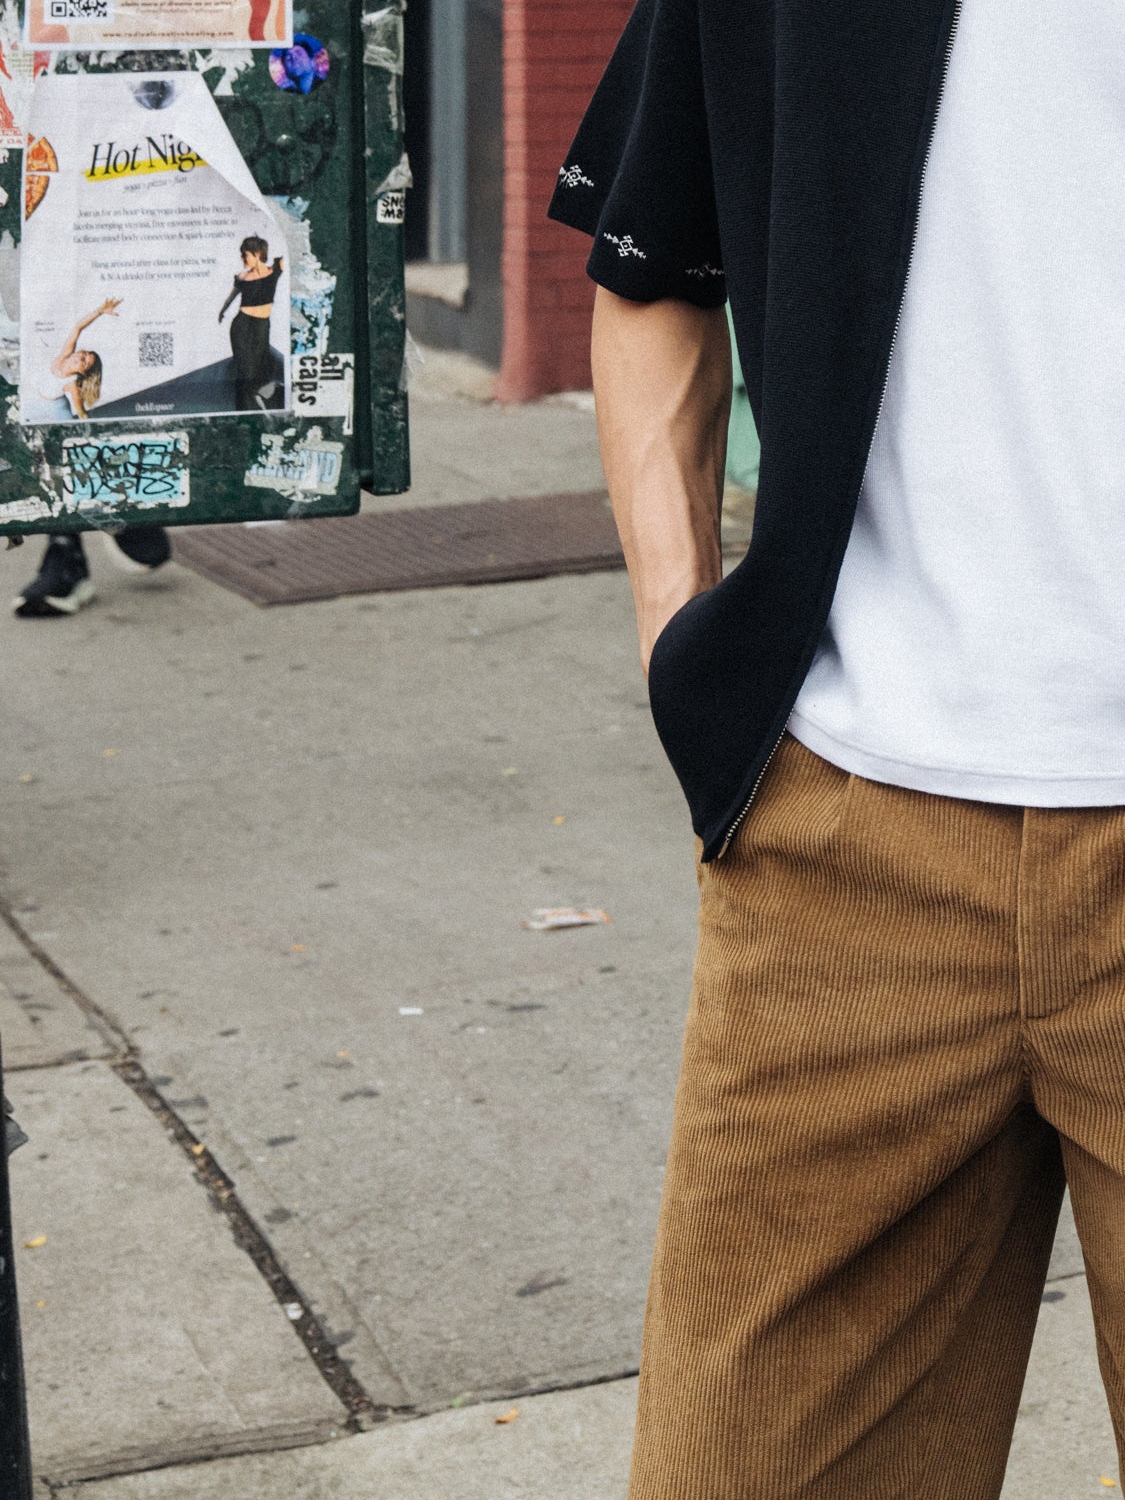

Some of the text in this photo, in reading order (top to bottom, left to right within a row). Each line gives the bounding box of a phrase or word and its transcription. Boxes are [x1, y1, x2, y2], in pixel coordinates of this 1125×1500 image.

[88, 132, 204, 177] Hot Nig
[296, 355, 318, 406] caps
[320, 355, 345, 380] all
